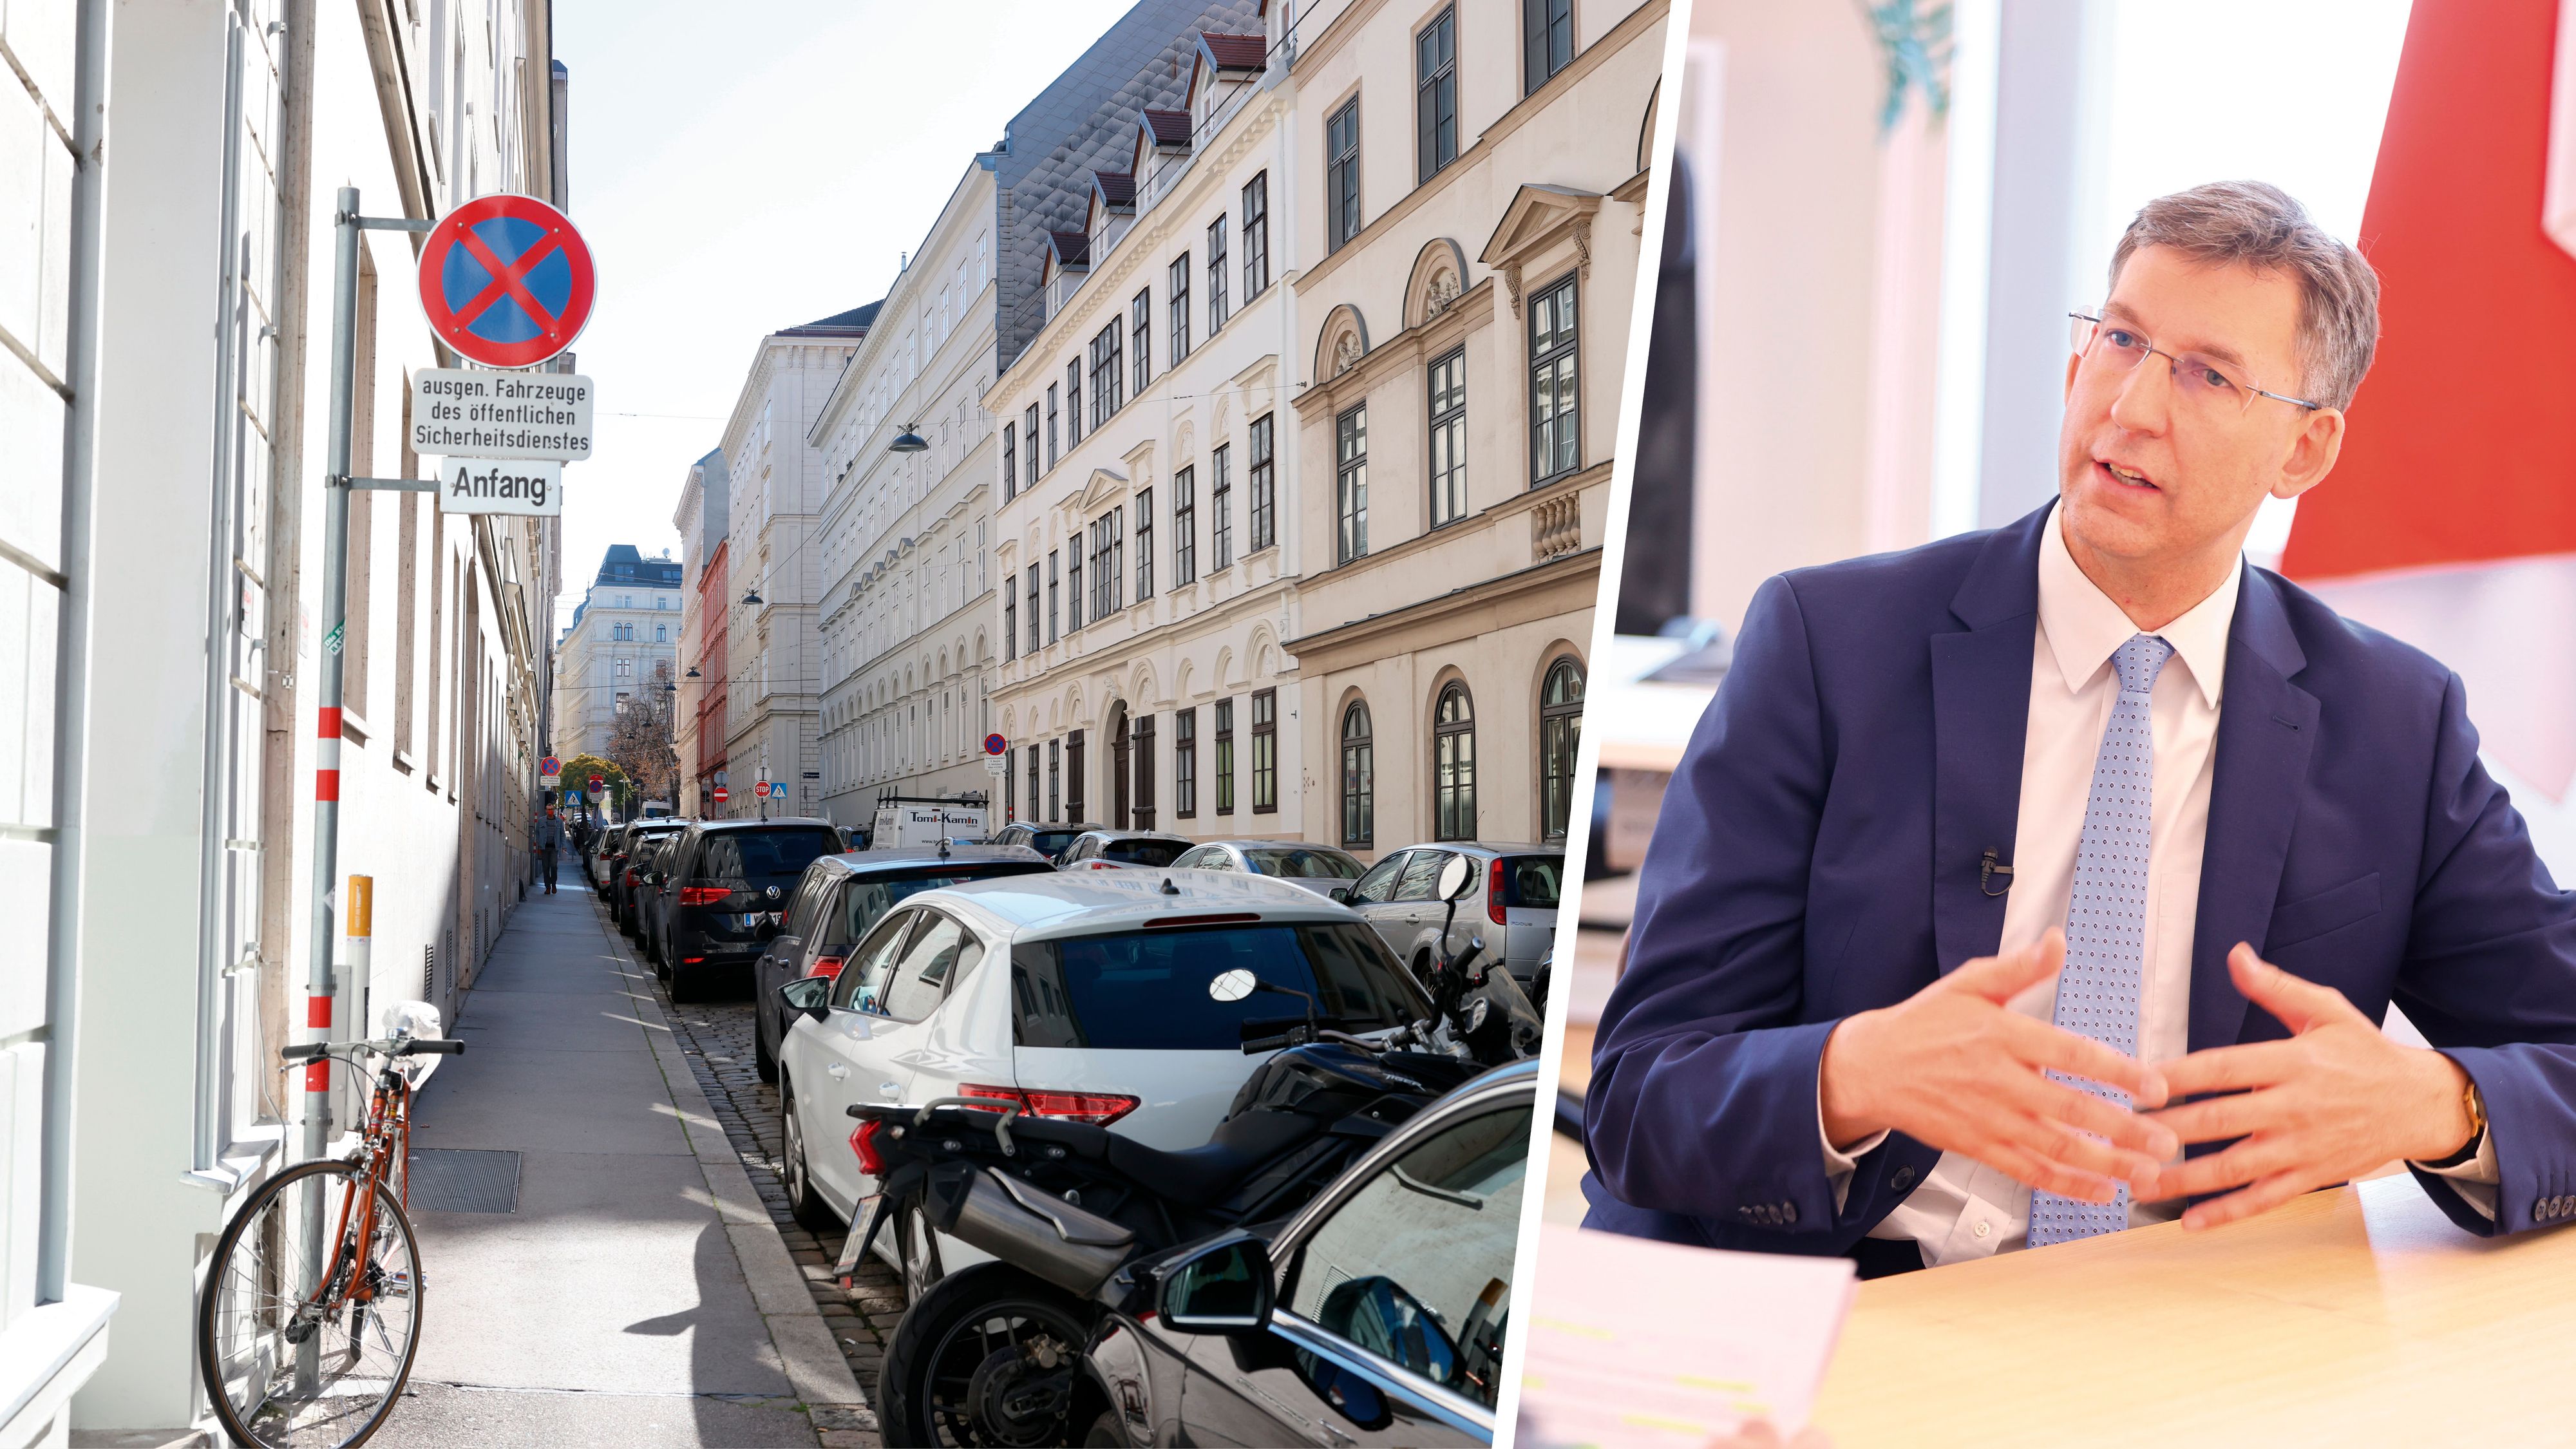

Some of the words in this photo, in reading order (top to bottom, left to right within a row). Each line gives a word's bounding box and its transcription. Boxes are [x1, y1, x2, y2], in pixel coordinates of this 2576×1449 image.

[422, 380, 489, 401] ausgen.
[496, 379, 585, 405] Fahrzeuge
[431, 401, 461, 420] des
[470, 403, 575, 425] öffentlichen
[417, 425, 589, 450] Sicherheitsdienstes
[453, 467, 546, 507] Anfang
[910, 811, 978, 824] Tomi-Kamin
